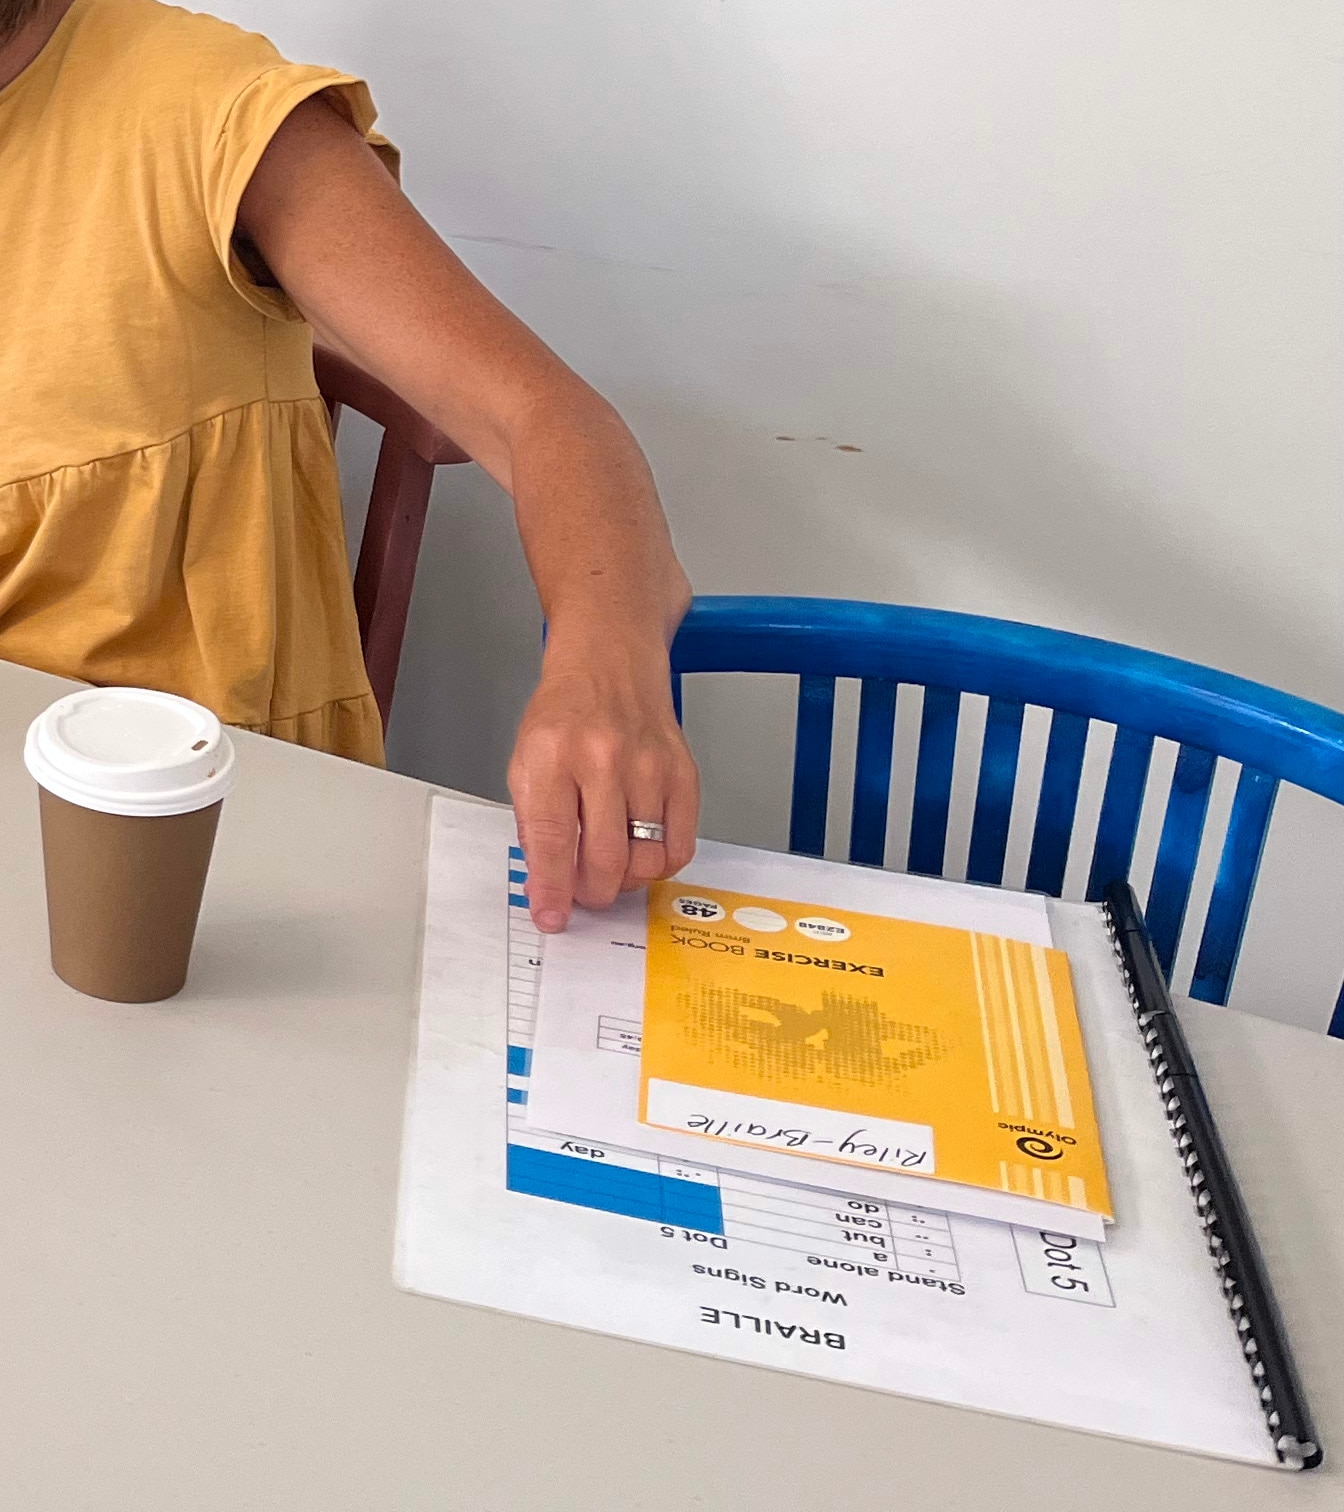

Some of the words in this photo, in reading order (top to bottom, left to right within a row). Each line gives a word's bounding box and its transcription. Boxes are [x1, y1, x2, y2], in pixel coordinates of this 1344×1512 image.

[678, 897, 718, 909] PAGES
[681, 903, 718, 919] 48
[670, 925, 710, 938] Ruled
[669, 933, 745, 956] BOOK
[754, 948, 884, 978] EXERCISE
[997, 1122, 1077, 1146] Olympic
[560, 1140, 605, 1161] day
[847, 1199, 879, 1217] do
[660, 1225, 674, 1240] 5
[834, 1212, 882, 1231] can
[680, 1228, 728, 1251] Dot
[841, 1229, 886, 1248] but
[873, 1251, 888, 1264] a
[1039, 1231, 1081, 1270] Dot
[691, 1263, 766, 1292] Signs
[806, 1255, 879, 1279] alone
[774, 1279, 847, 1307] Word
[888, 1270, 966, 1296] Stand
[1051, 1275, 1089, 1293] 5
[699, 1305, 846, 1351] BRAILLE
